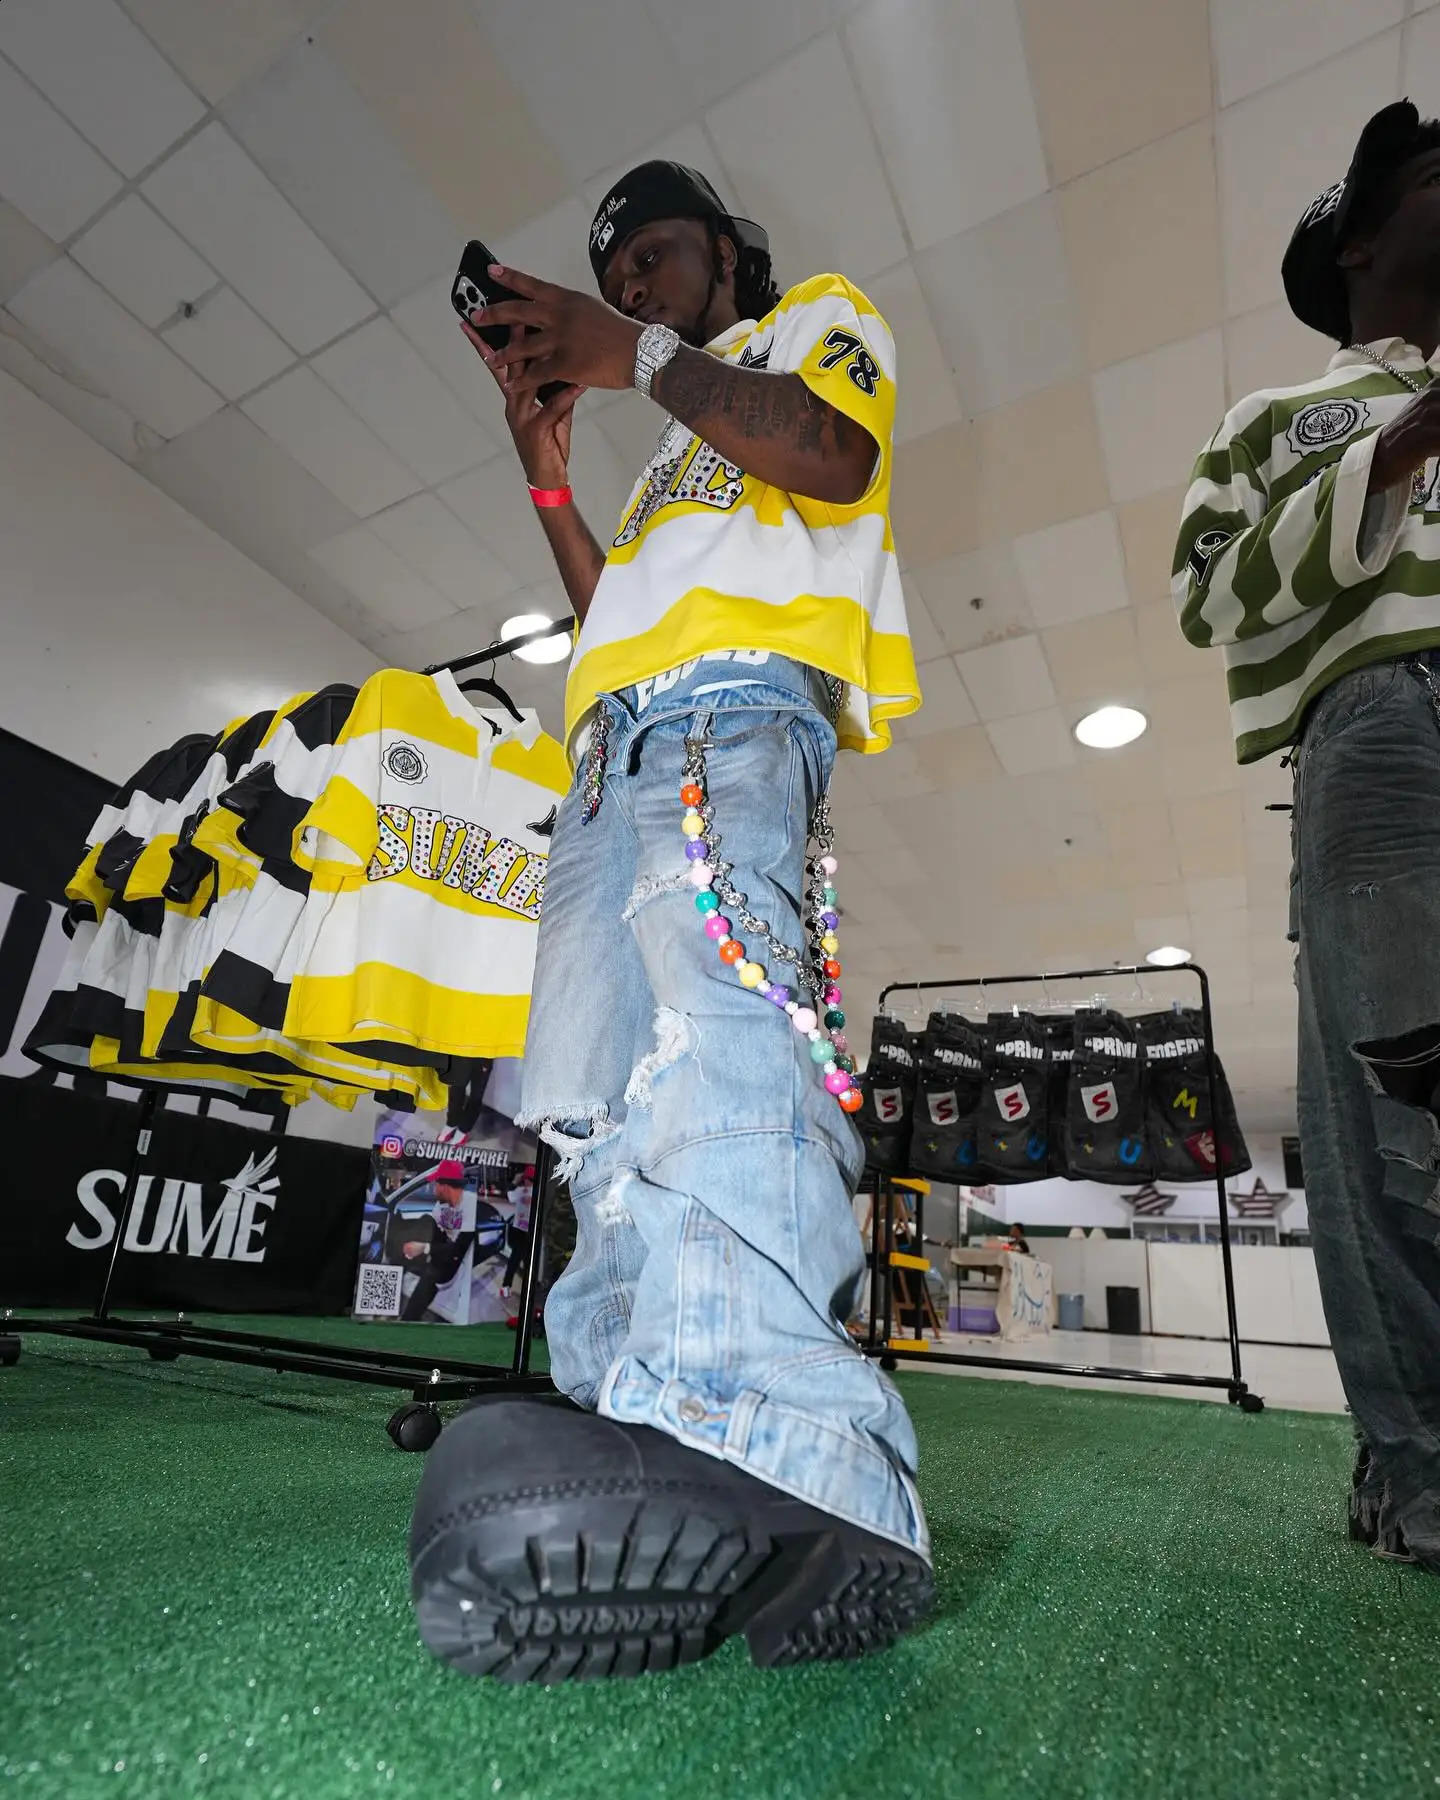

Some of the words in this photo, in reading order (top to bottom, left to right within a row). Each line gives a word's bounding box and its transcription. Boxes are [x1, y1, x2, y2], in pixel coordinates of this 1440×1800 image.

[819, 328, 880, 397] 78
[881, 1095, 898, 1118] S
[936, 1098, 953, 1122] S
[1003, 1092, 1023, 1119] S
[1092, 1090, 1111, 1117] S
[1173, 1088, 1198, 1119] M
[404, 1139, 511, 1168] @SUMEAPPAREL
[1120, 1136, 1142, 1165] U
